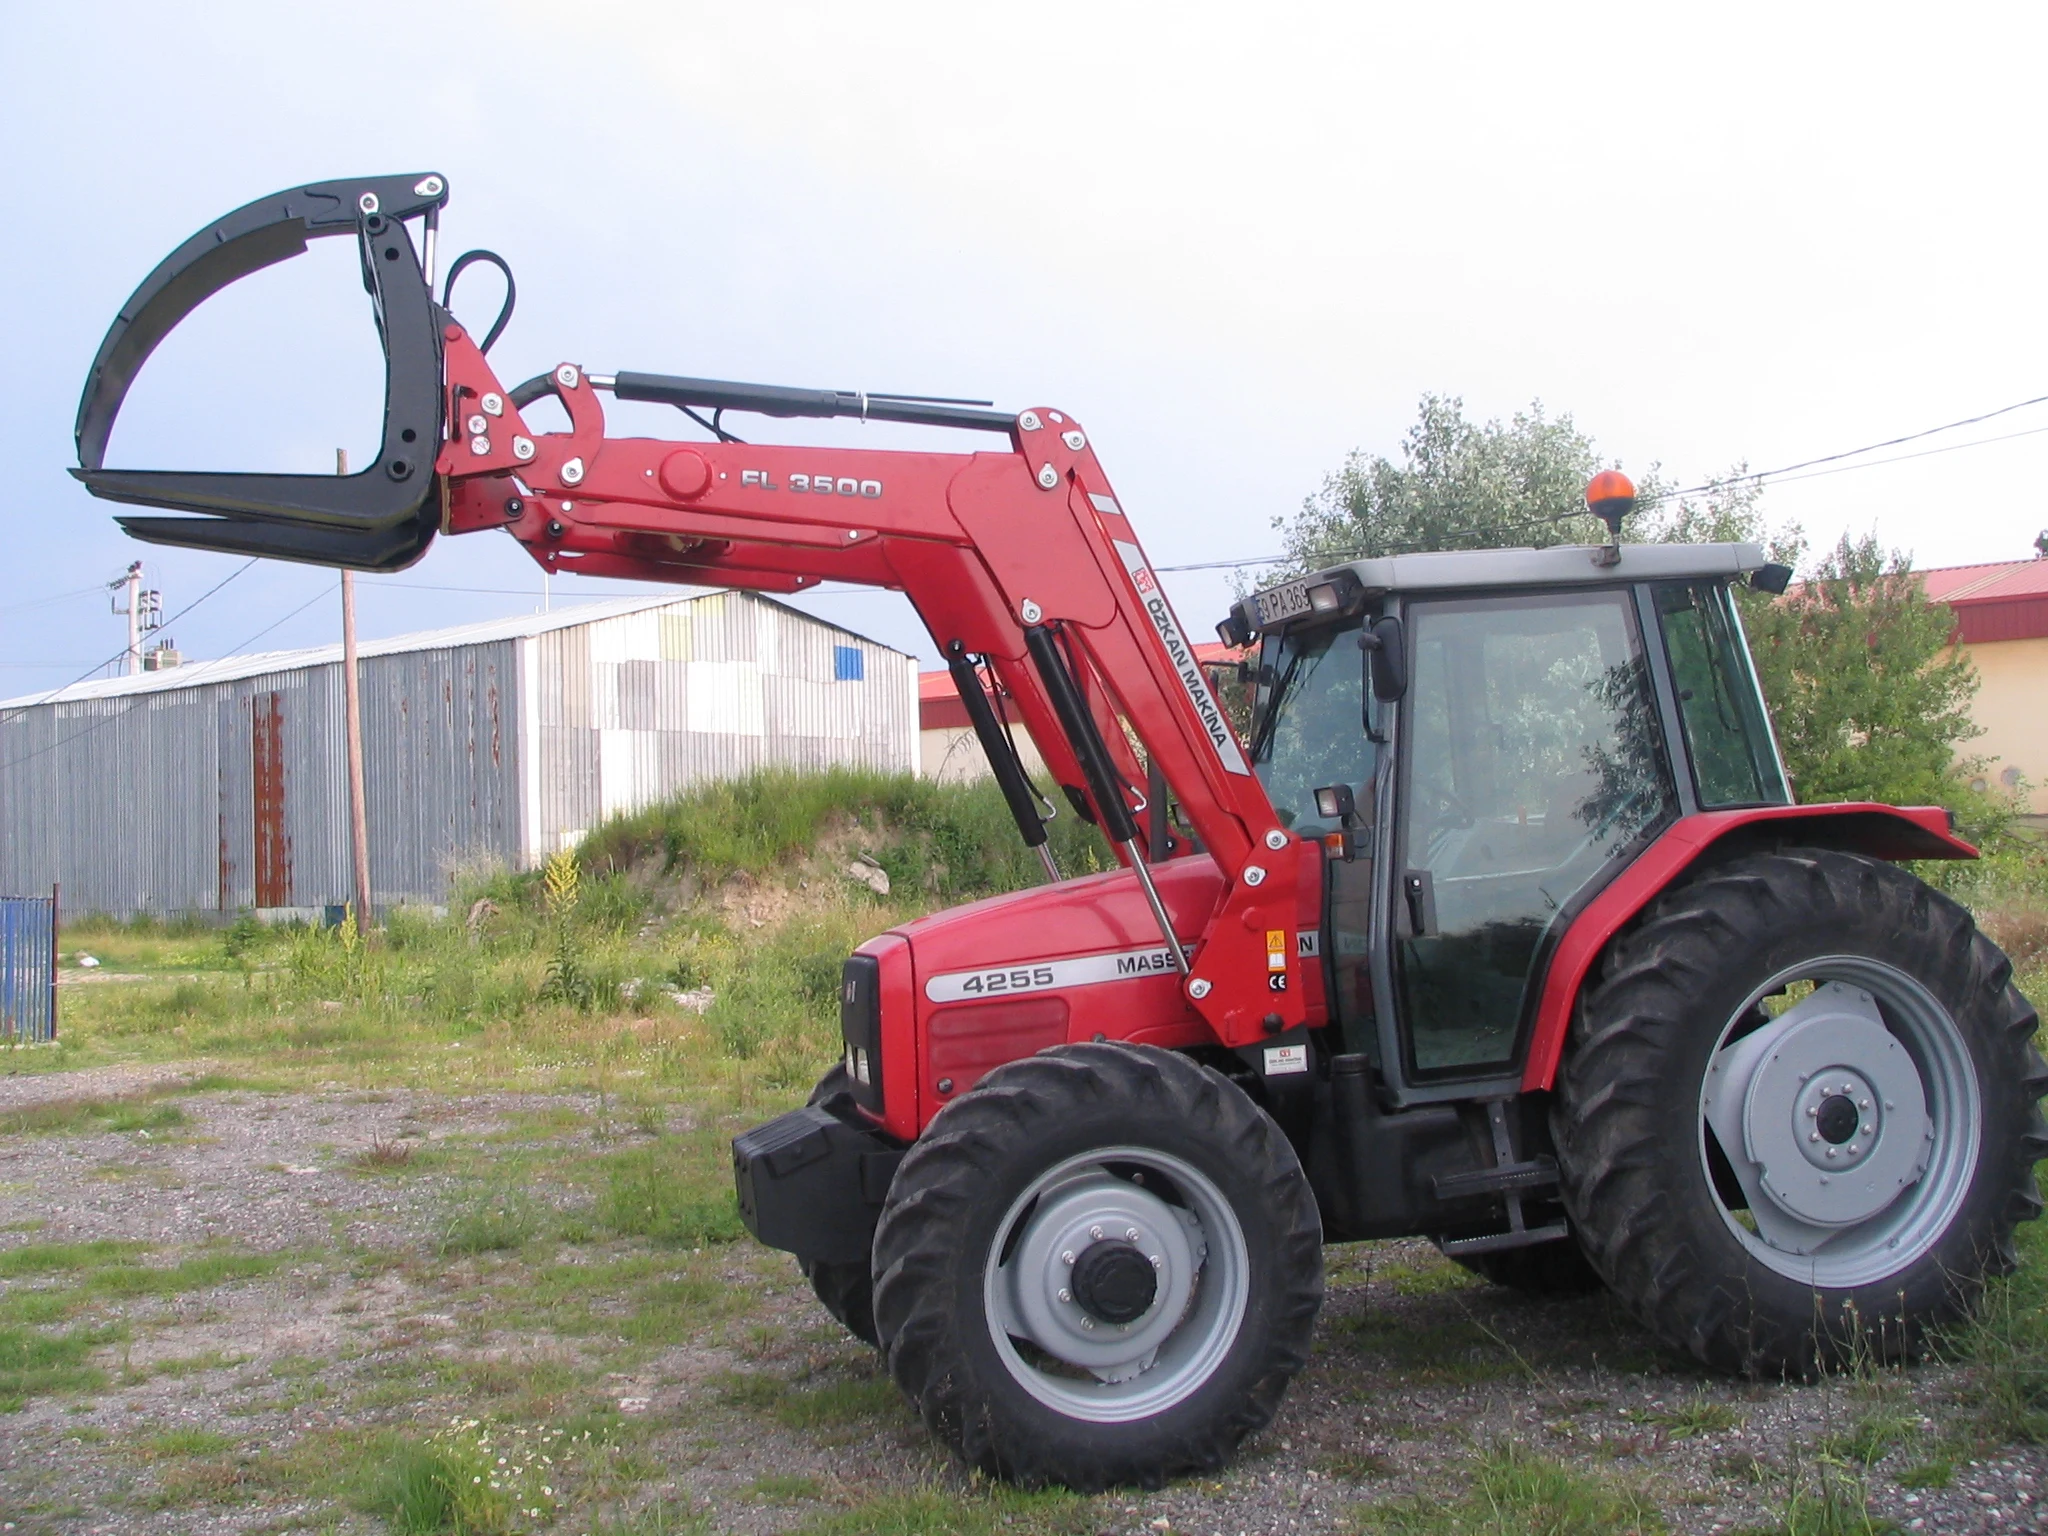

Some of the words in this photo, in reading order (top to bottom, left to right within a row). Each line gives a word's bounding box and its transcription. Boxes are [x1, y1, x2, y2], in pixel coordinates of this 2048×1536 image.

[741, 469, 778, 491] FL
[788, 473, 883, 499] 3500
[1269, 592, 1288, 618] PA
[1287, 583, 1310, 611] 369
[1147, 597, 1189, 667] ÖZKAN
[1182, 669, 1228, 749] MAKİNA
[962, 967, 1054, 994] 4255
[1268, 974, 1286, 990] CE
